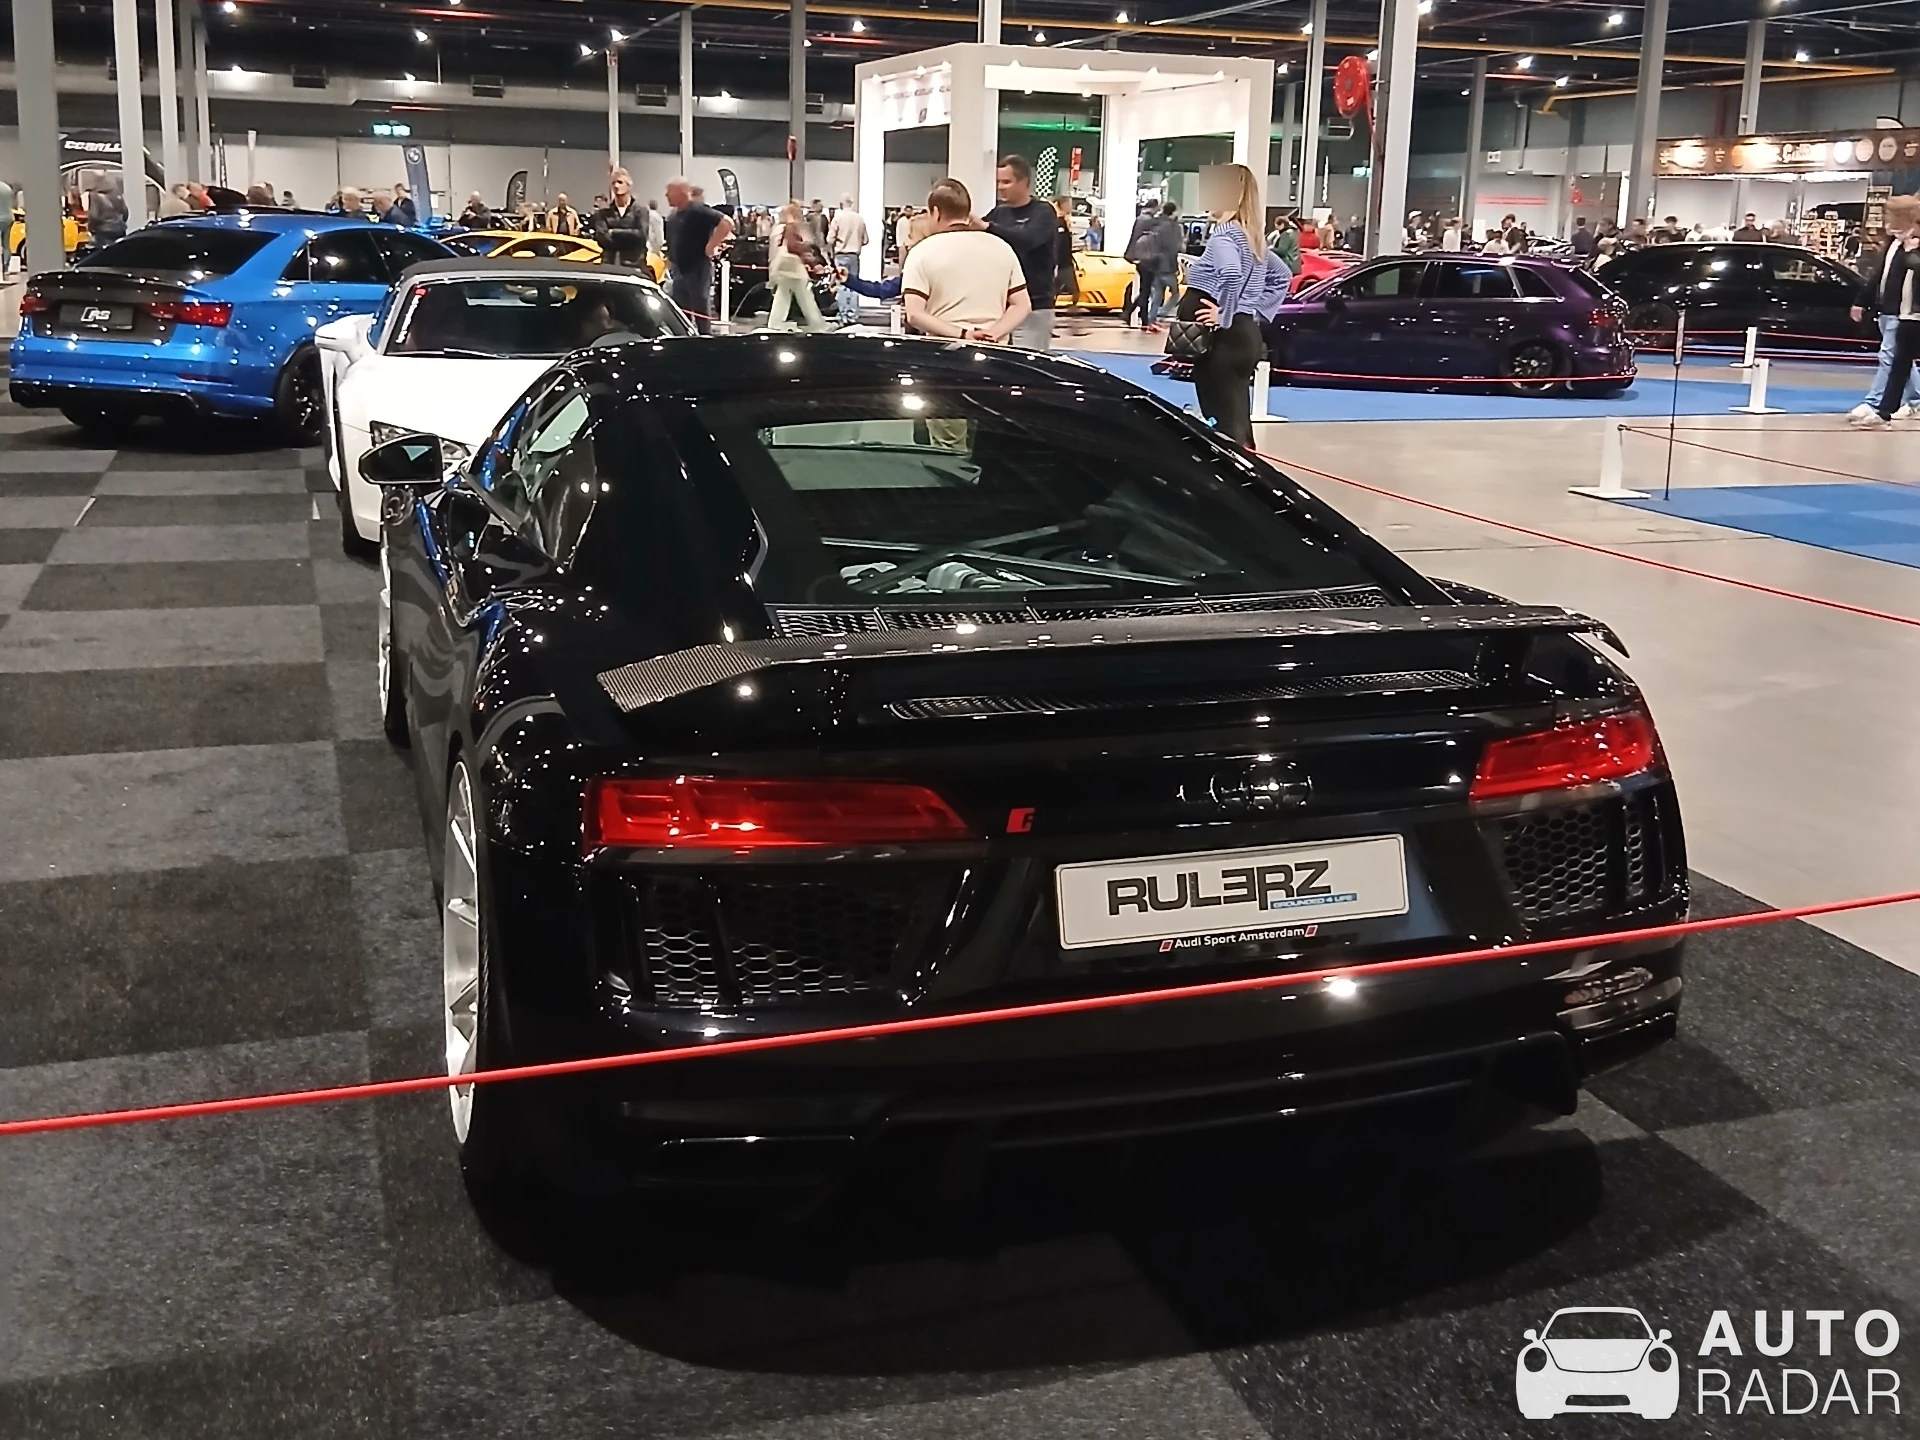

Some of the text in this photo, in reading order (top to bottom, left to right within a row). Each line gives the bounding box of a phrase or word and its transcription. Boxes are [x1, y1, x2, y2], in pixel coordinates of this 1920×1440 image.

[85, 308, 111, 320] RS
[1273, 897, 1325, 909] GROUNDED
[1174, 927, 1305, 949] Audi Sport Amsterdam
